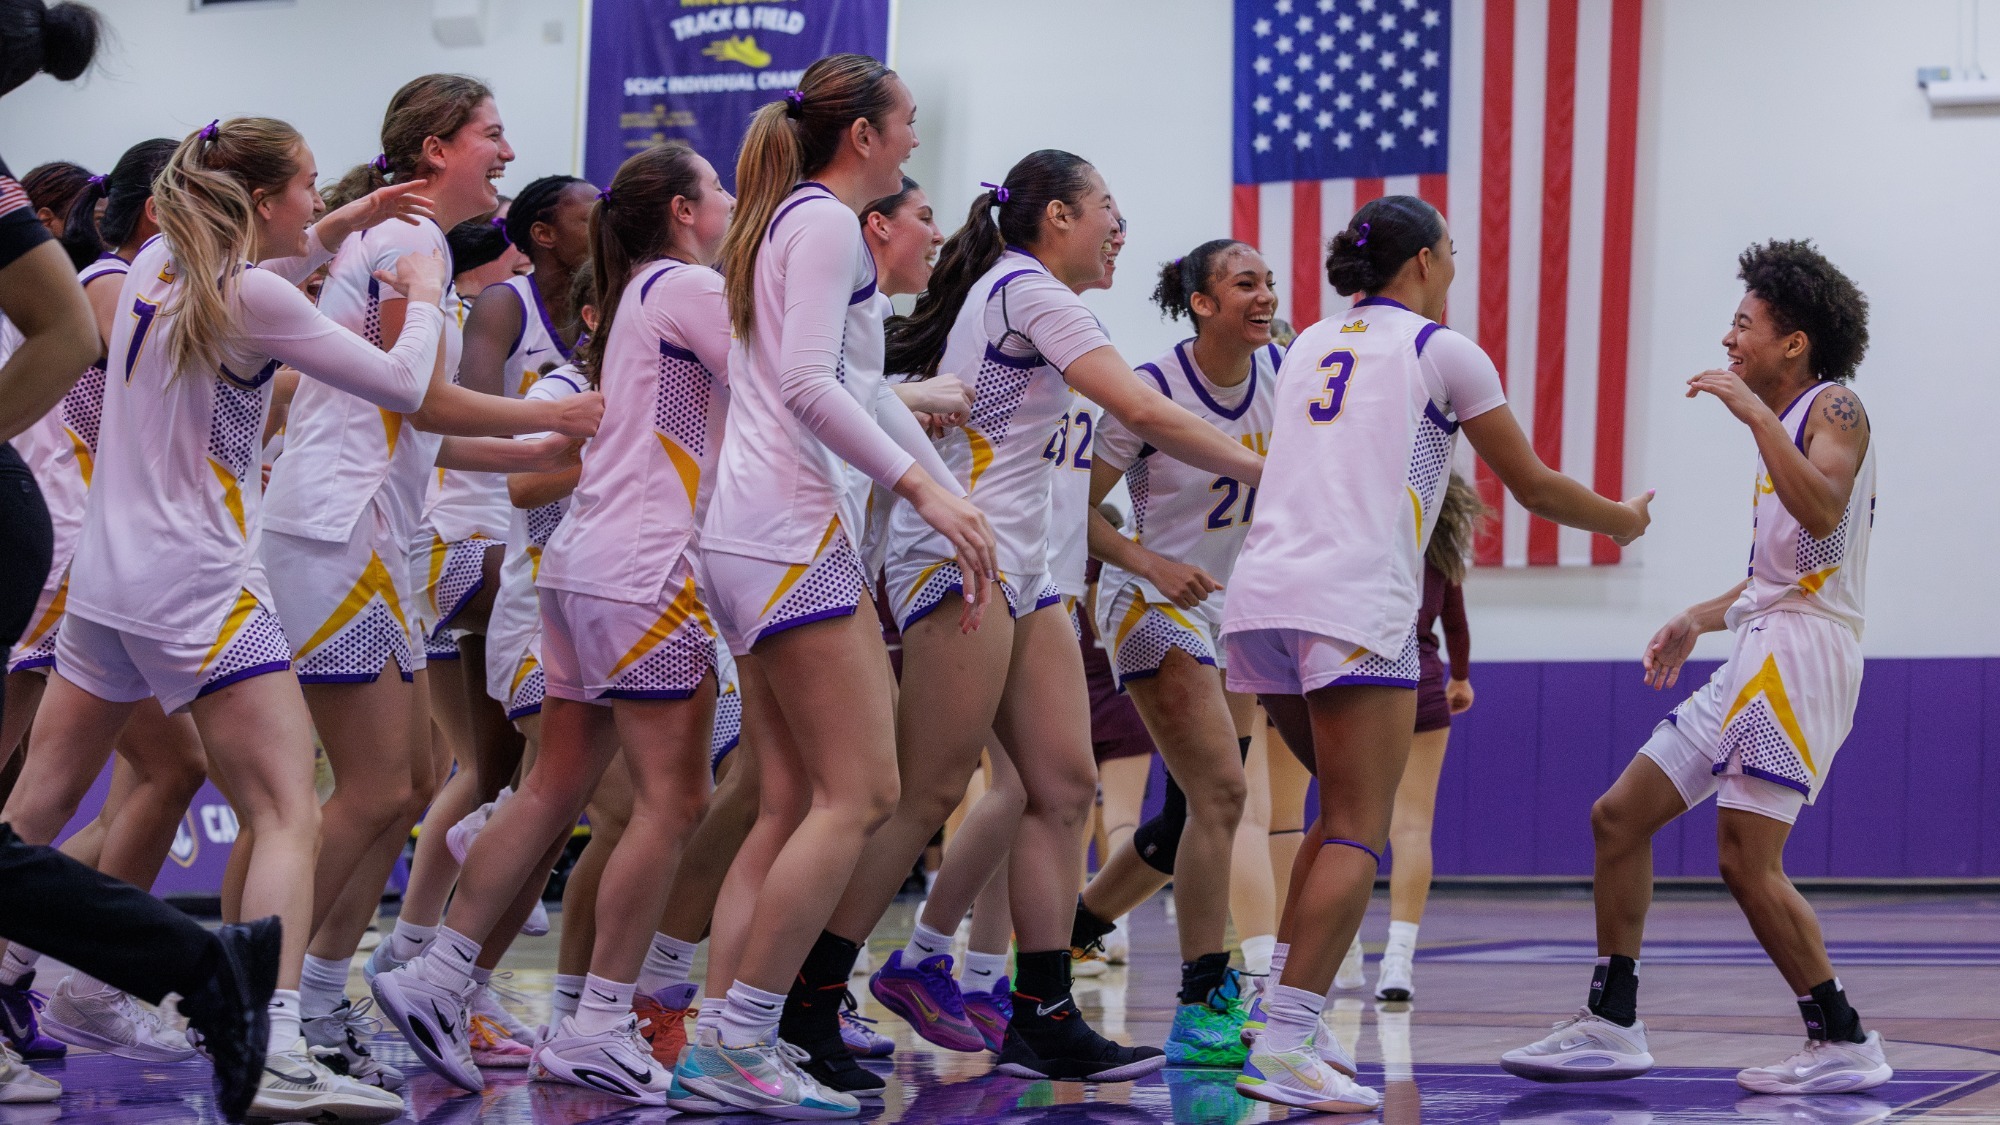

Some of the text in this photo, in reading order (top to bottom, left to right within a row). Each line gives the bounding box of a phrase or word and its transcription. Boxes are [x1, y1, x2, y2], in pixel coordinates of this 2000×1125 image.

[670, 5, 806, 41] TRACK & FIELD
[668, 74, 756, 94] INDIVIDUAL
[1306, 347, 1359, 425] 3
